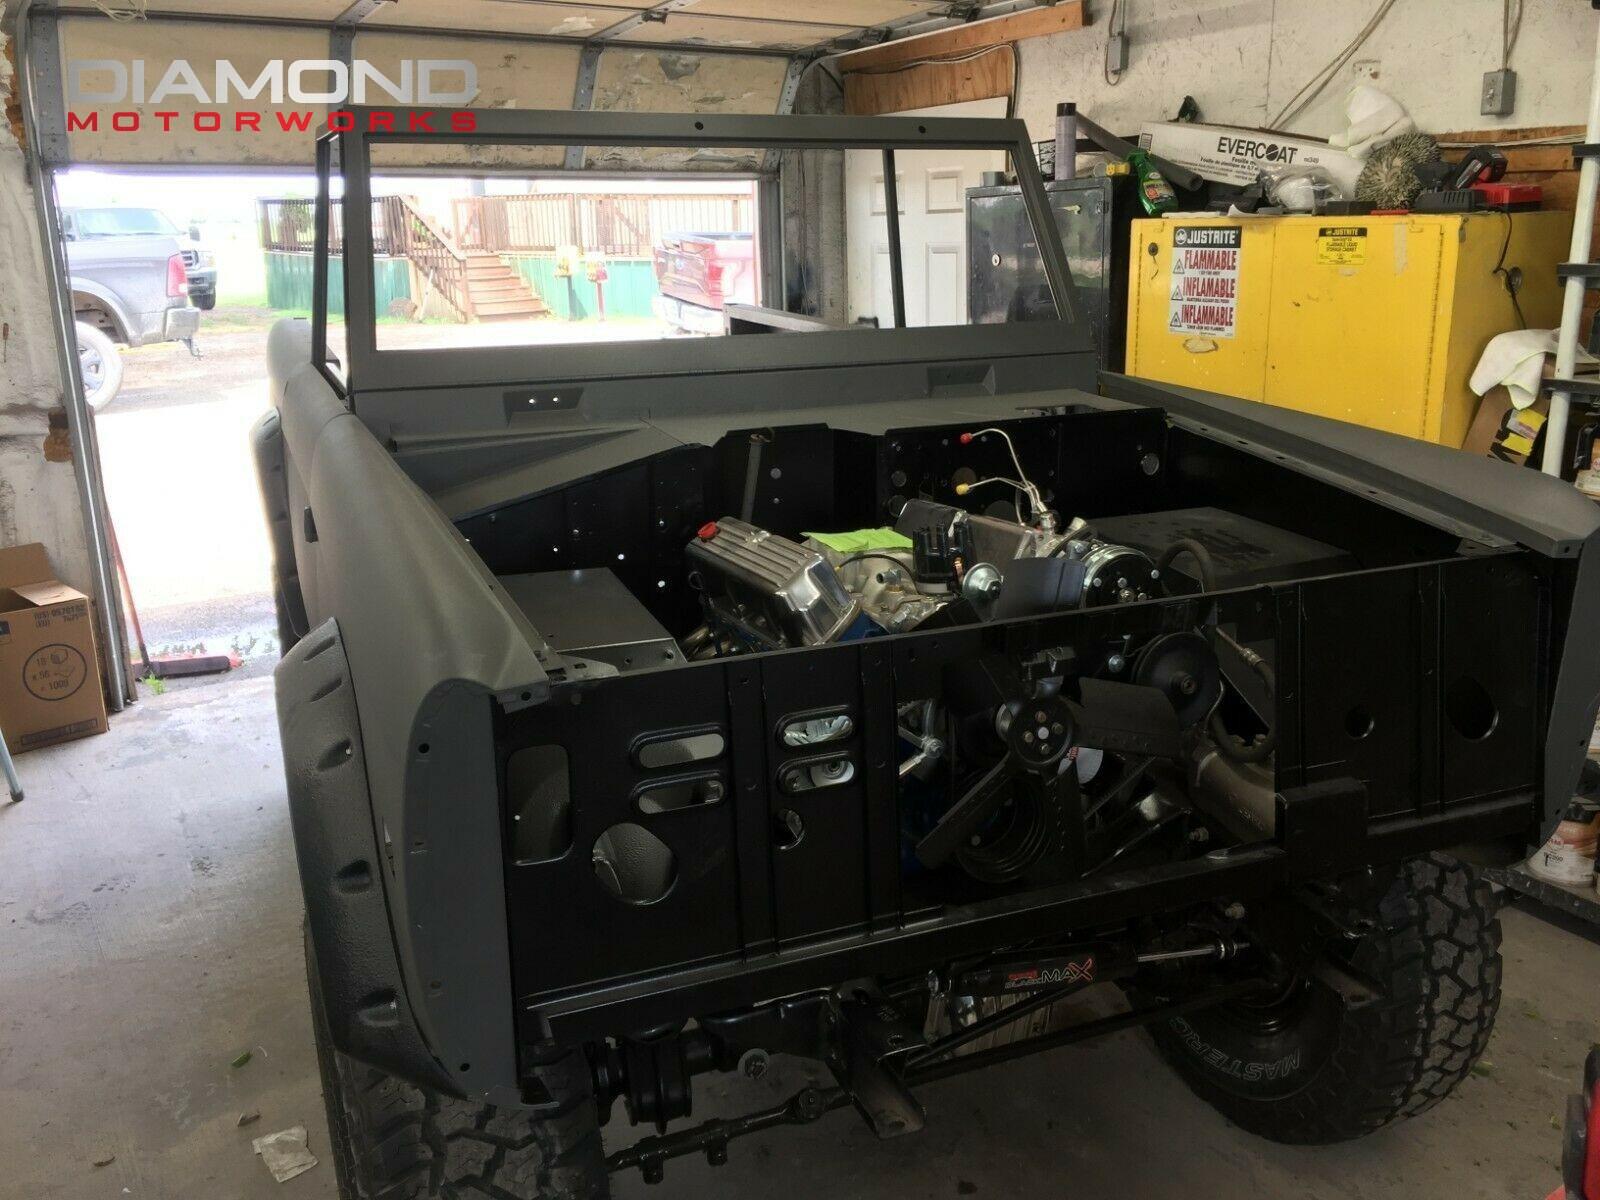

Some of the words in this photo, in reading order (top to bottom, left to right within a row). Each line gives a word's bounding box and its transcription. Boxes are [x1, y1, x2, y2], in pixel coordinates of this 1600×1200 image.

[1217, 136, 1298, 164] EVERCOAT
[1187, 230, 1236, 244] JUSTRITE
[1184, 249, 1237, 271] FLAMMABLE
[1182, 276, 1236, 299] INFLAMABLE
[1181, 304, 1234, 327] INFLAMMABLE
